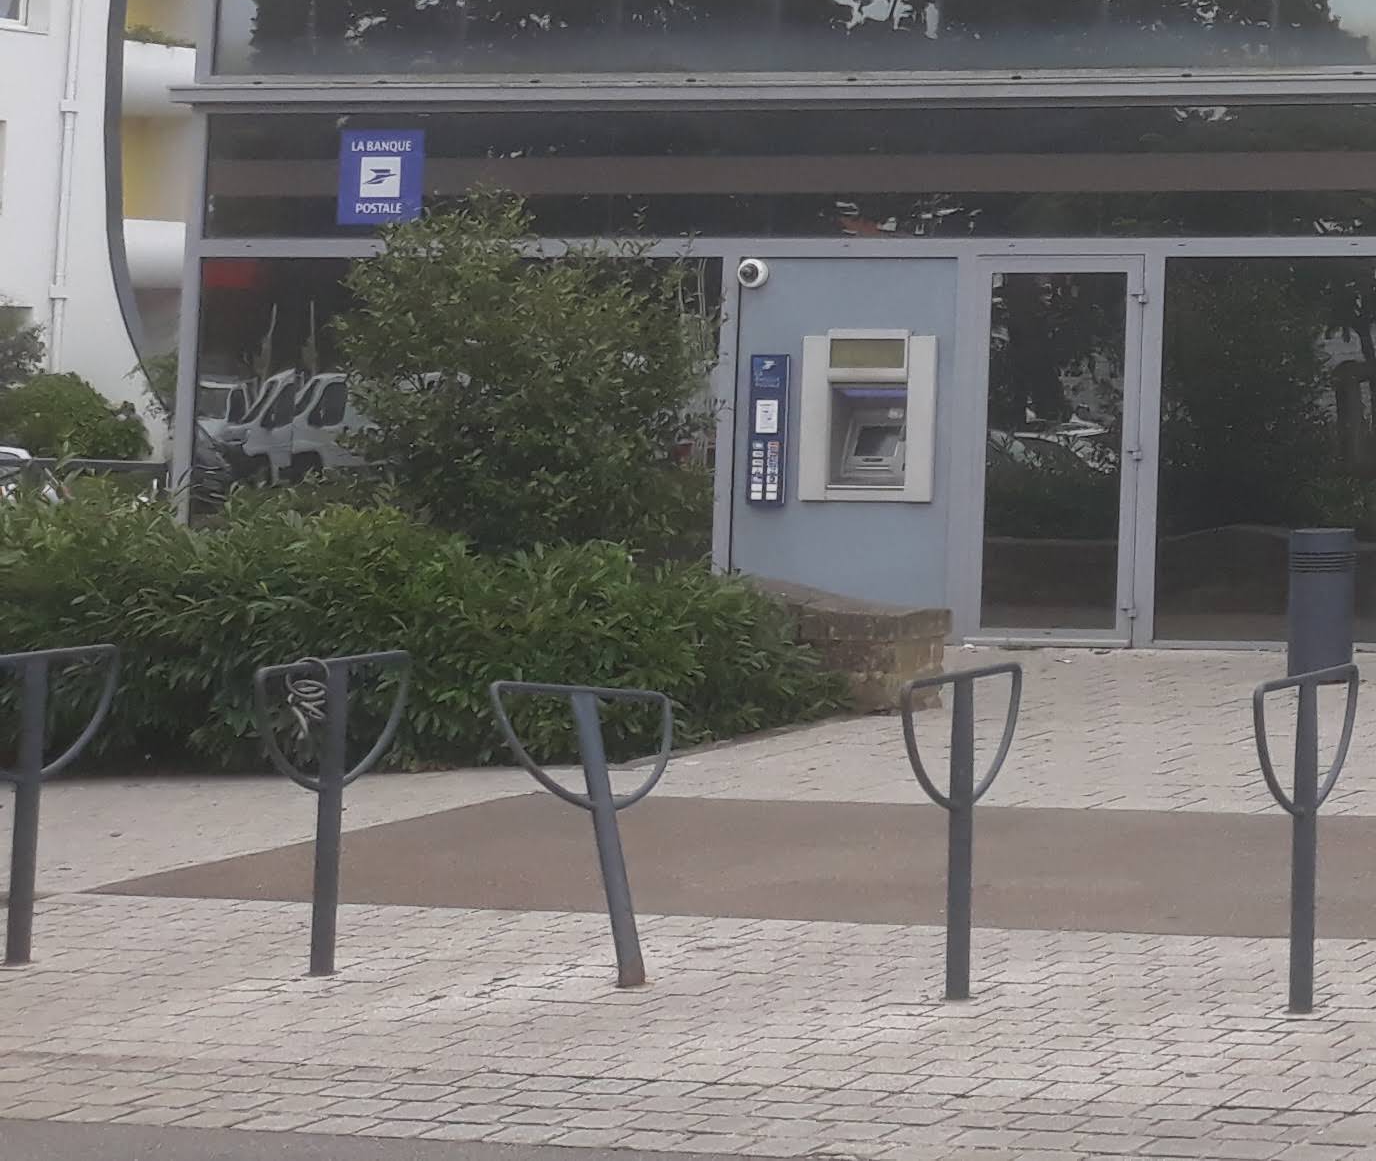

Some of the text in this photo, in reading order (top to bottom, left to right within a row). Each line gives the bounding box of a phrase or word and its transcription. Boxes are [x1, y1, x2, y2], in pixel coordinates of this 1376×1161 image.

[351, 140, 412, 153] LA BANQUE
[355, 202, 403, 214] POSTALE
